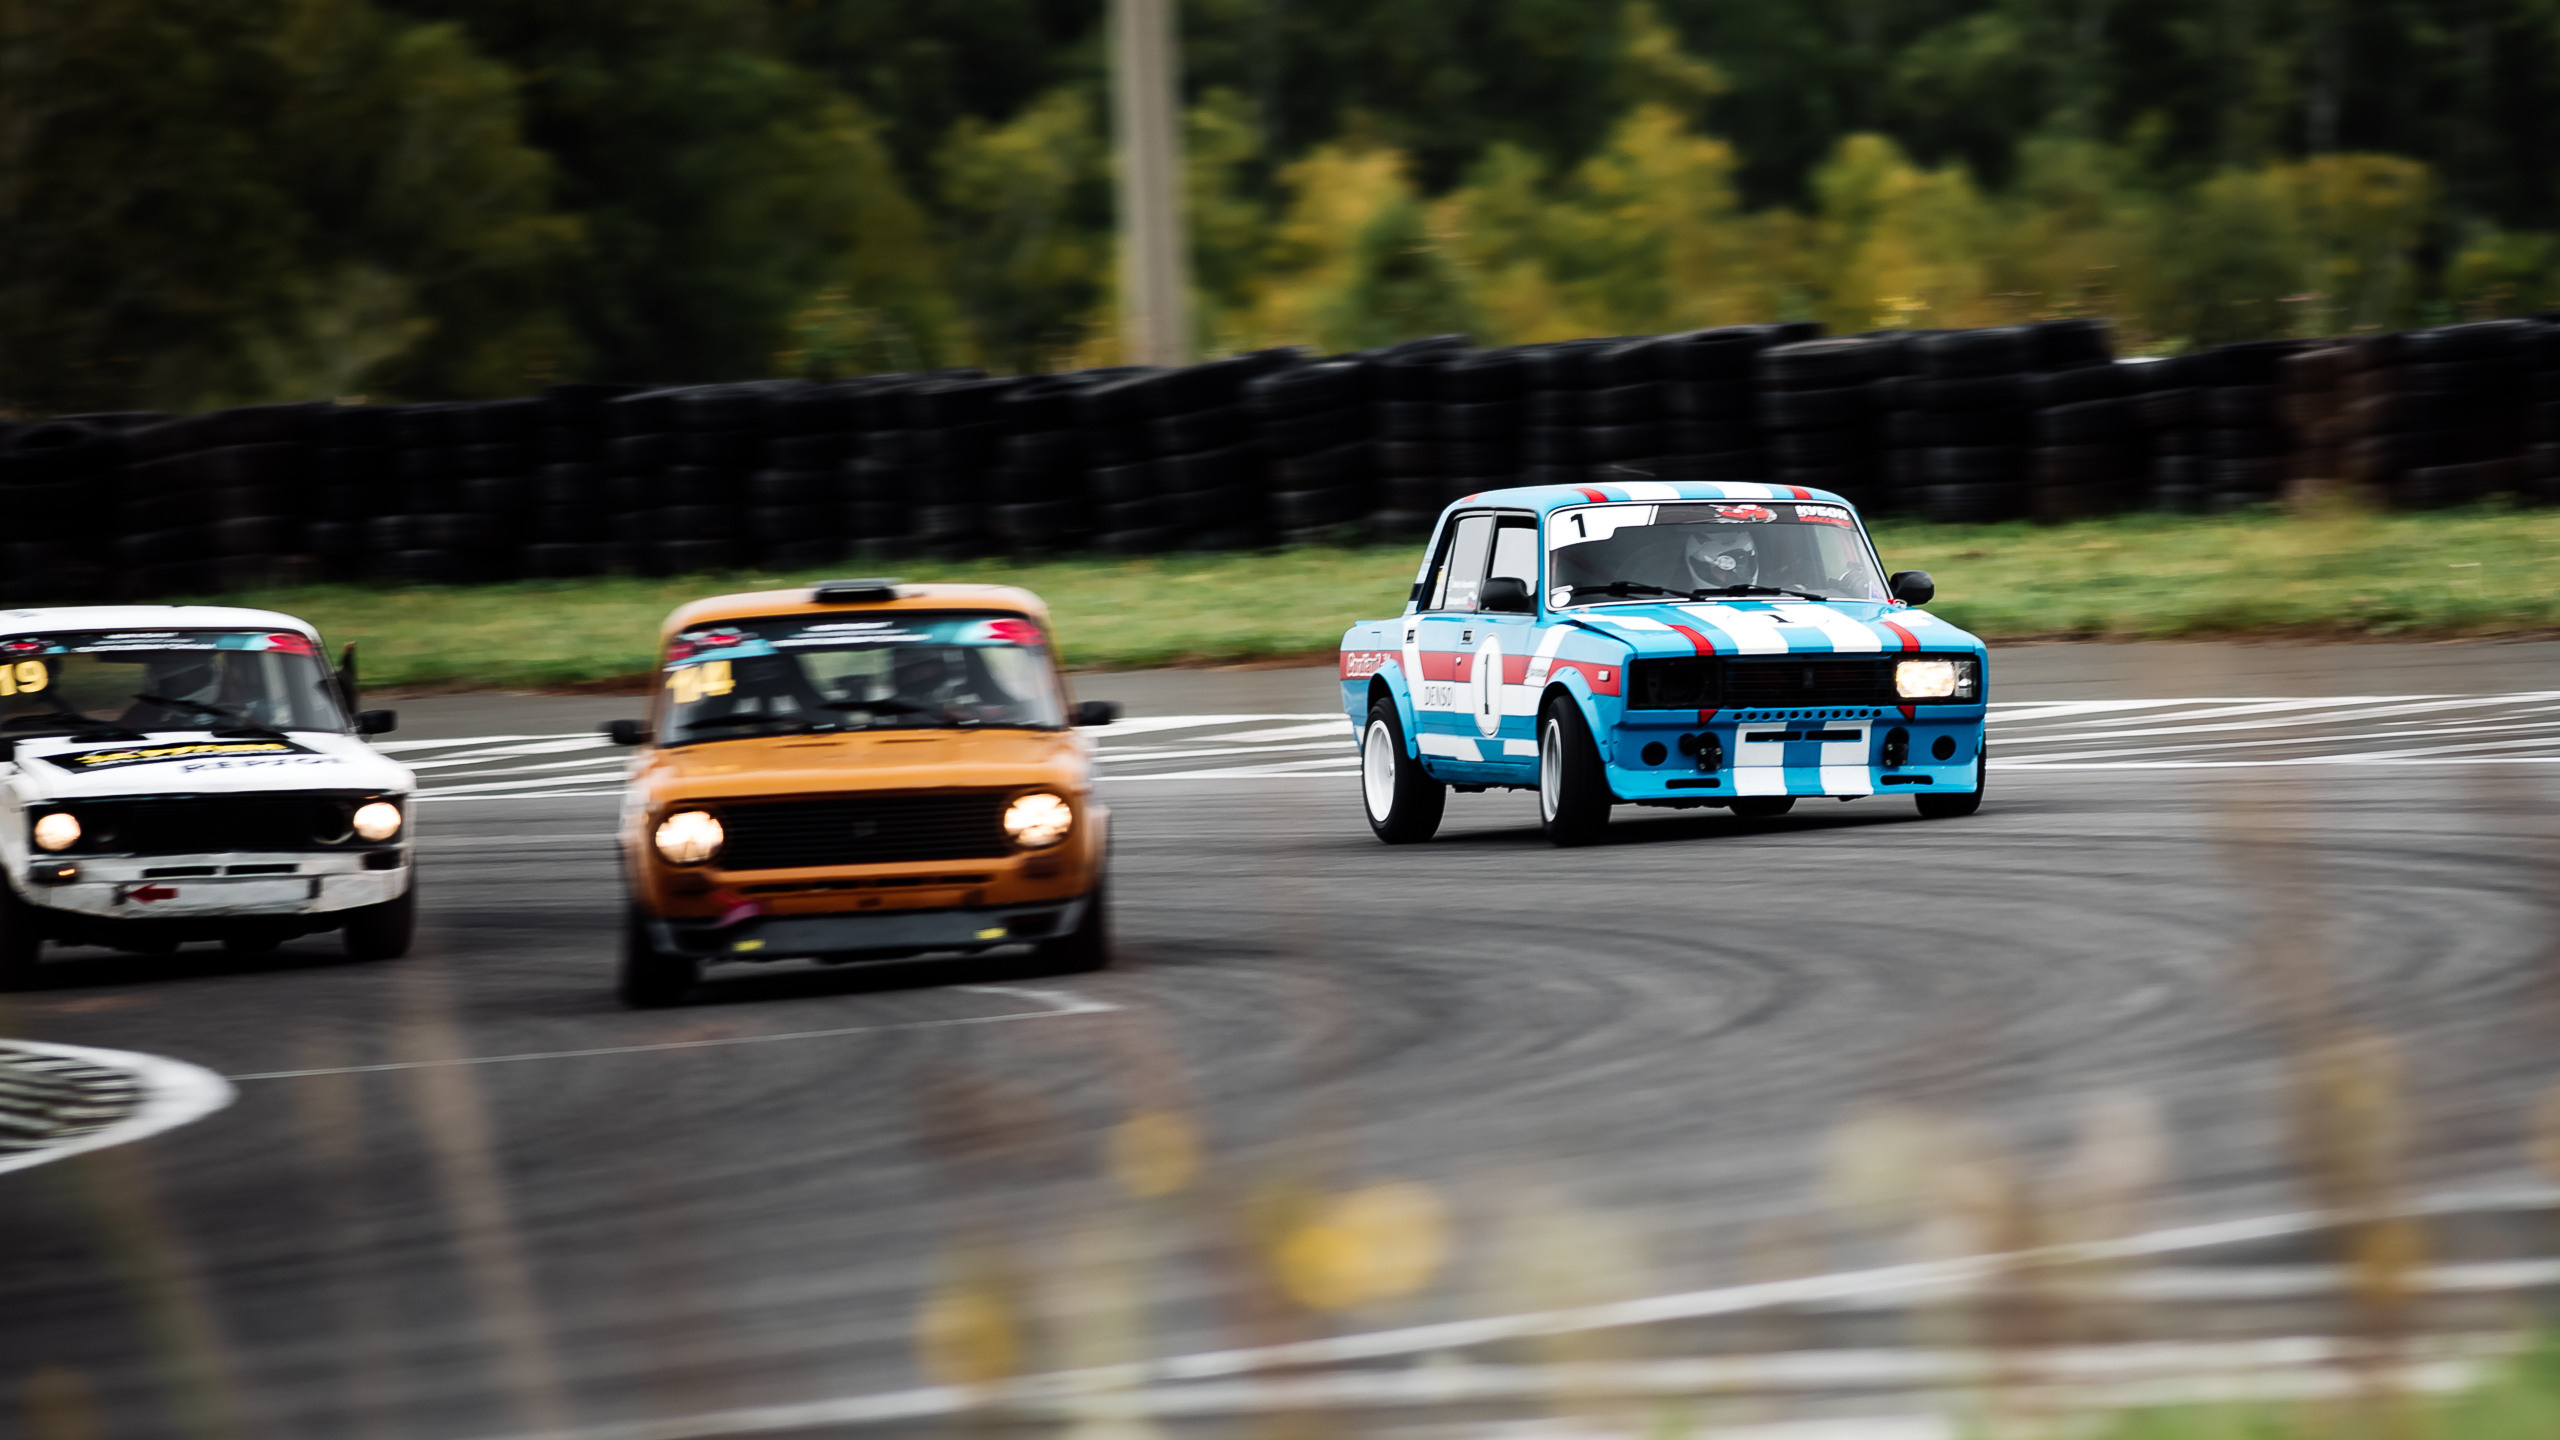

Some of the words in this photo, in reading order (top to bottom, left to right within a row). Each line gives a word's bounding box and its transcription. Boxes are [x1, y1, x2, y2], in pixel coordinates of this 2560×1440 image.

[1570, 513, 1587, 538] 1
[1795, 505, 1850, 521] КУБОК
[0, 660, 49, 696] 19
[665, 660, 737, 704] 14
[1484, 653, 1491, 715] 1
[1424, 686, 1454, 706] DENSO
